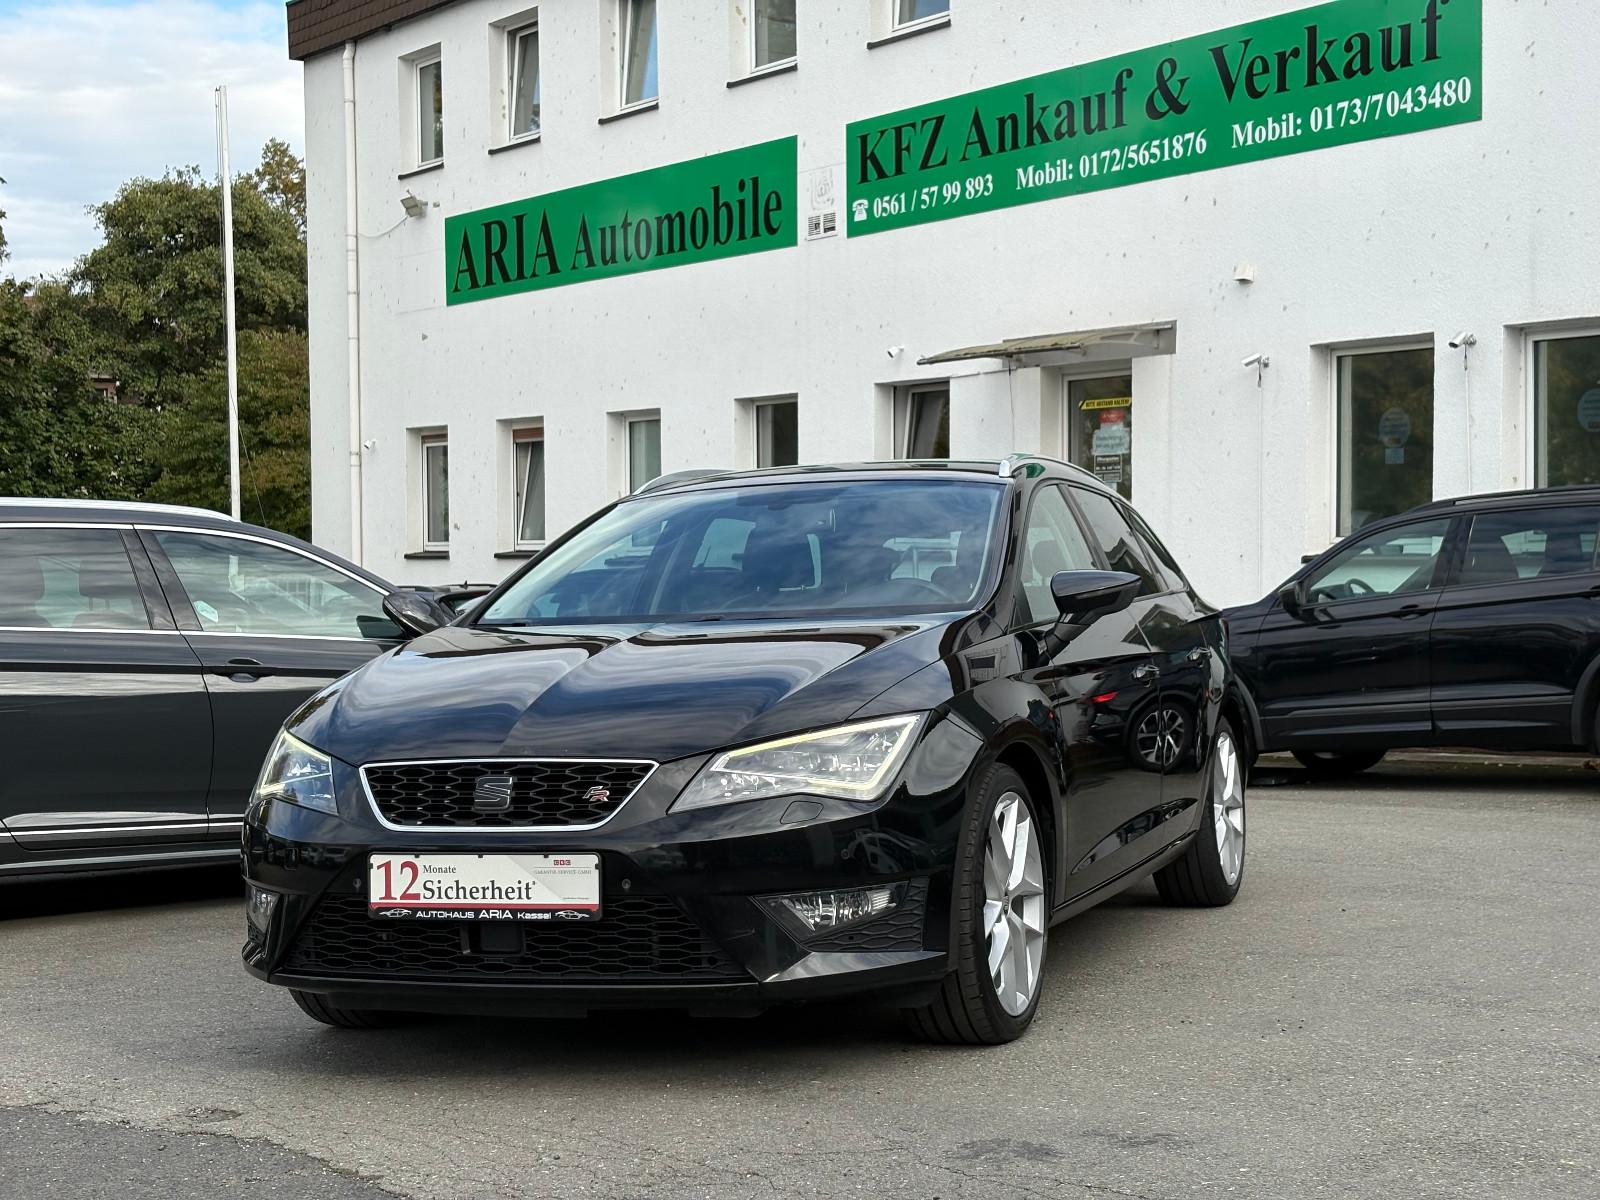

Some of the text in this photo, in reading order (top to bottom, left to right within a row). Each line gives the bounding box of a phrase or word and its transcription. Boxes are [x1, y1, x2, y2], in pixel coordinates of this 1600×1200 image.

[857, 0, 1450, 185] KFZ Ankauf & Verkauf
[1231, 75, 1473, 149] Mobil: 0173/7043480
[1015, 127, 1208, 191] Mobil: 0172/5651876
[872, 192, 908, 219] 0561
[920, 186, 939, 210] 57
[942, 180, 962, 205] 99
[965, 173, 995, 201] 893
[451, 176, 784, 294] ARIA Automobile
[376, 859, 421, 901] 12
[422, 864, 457, 874] Monate
[415, 909, 552, 920] AUTOHAUS ARIA Kassel
